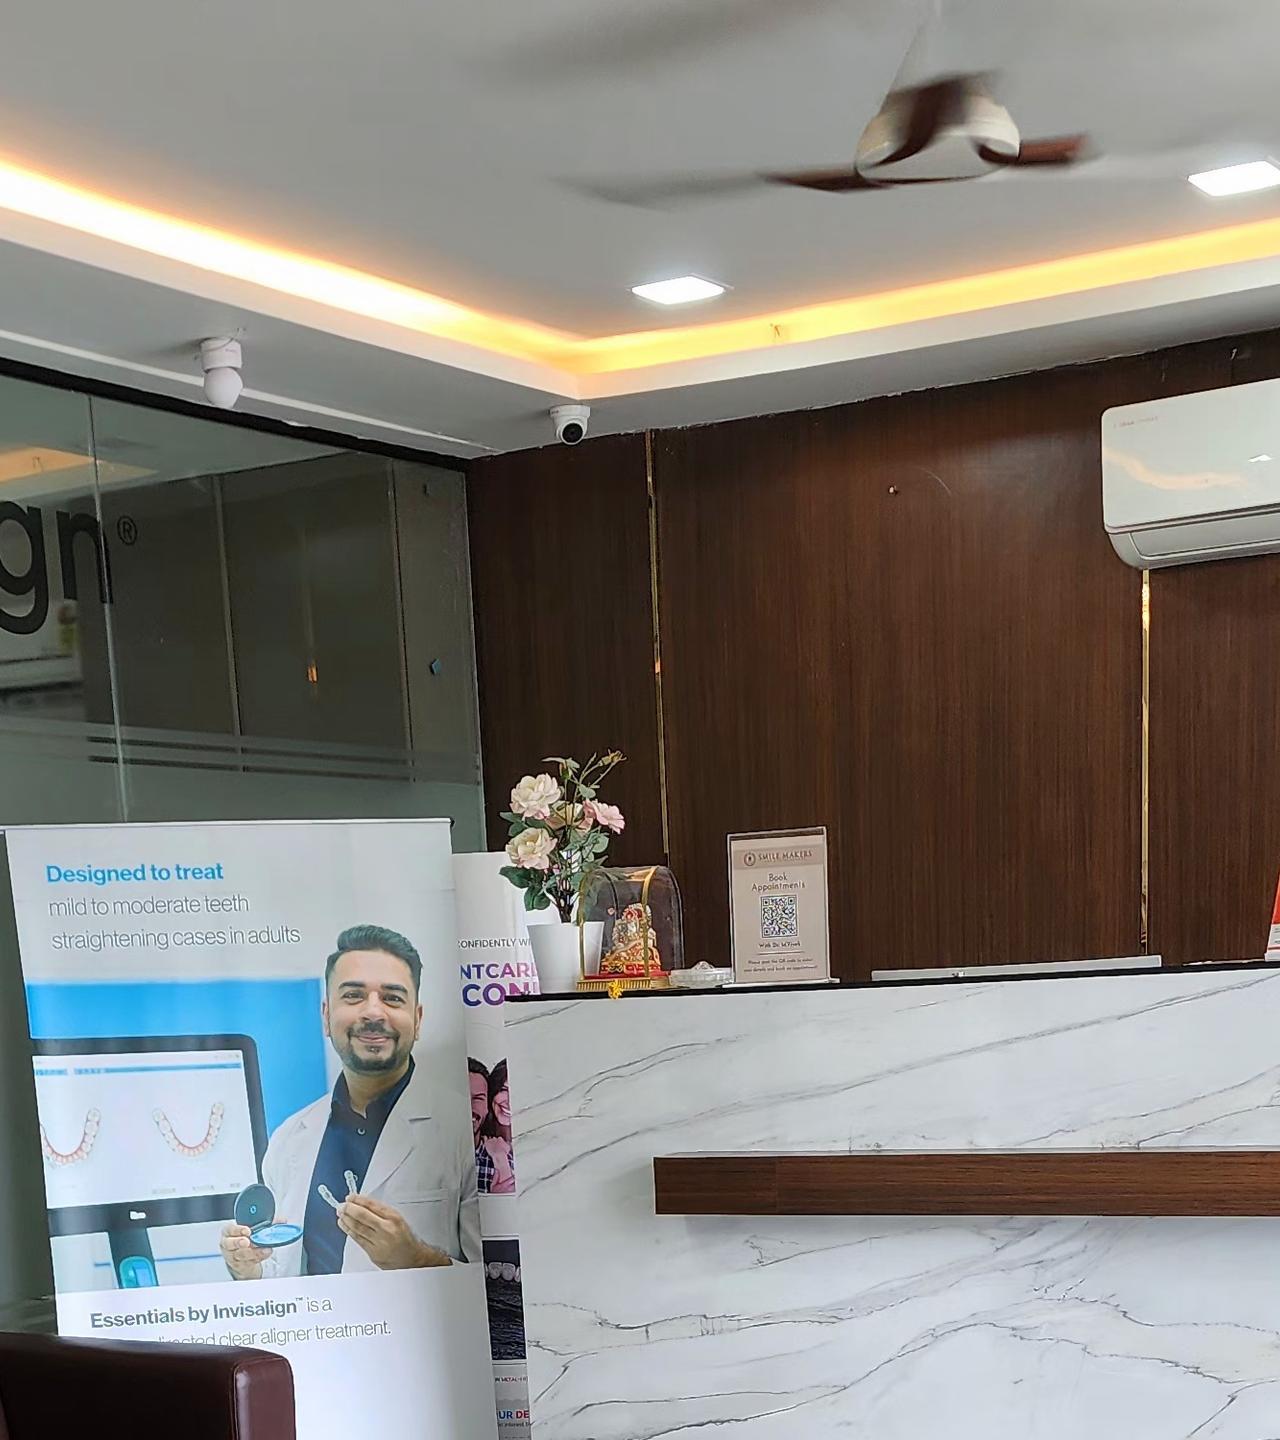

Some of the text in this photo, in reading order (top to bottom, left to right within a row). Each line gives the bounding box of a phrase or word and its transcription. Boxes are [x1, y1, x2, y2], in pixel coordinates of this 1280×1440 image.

[758, 850, 812, 862] SMILE MAKERS
[46, 863, 224, 885] Designed to treat
[768, 871, 787, 881] Book
[751, 882, 805, 892] Appointments
[49, 894, 249, 916] mild to moderate teeth
[52, 925, 300, 951] straightening cases in adults
[458, 938, 515, 948] ONFIDENTLY
[90, 1306, 185, 1329] Essentials
[188, 1305, 209, 1323] by
[306, 1298, 320, 1312] is
[322, 1300, 332, 1312] a
[218, 1330, 257, 1346] clear
[260, 1326, 312, 1348] aligner
[315, 1320, 391, 1341] treatment.
